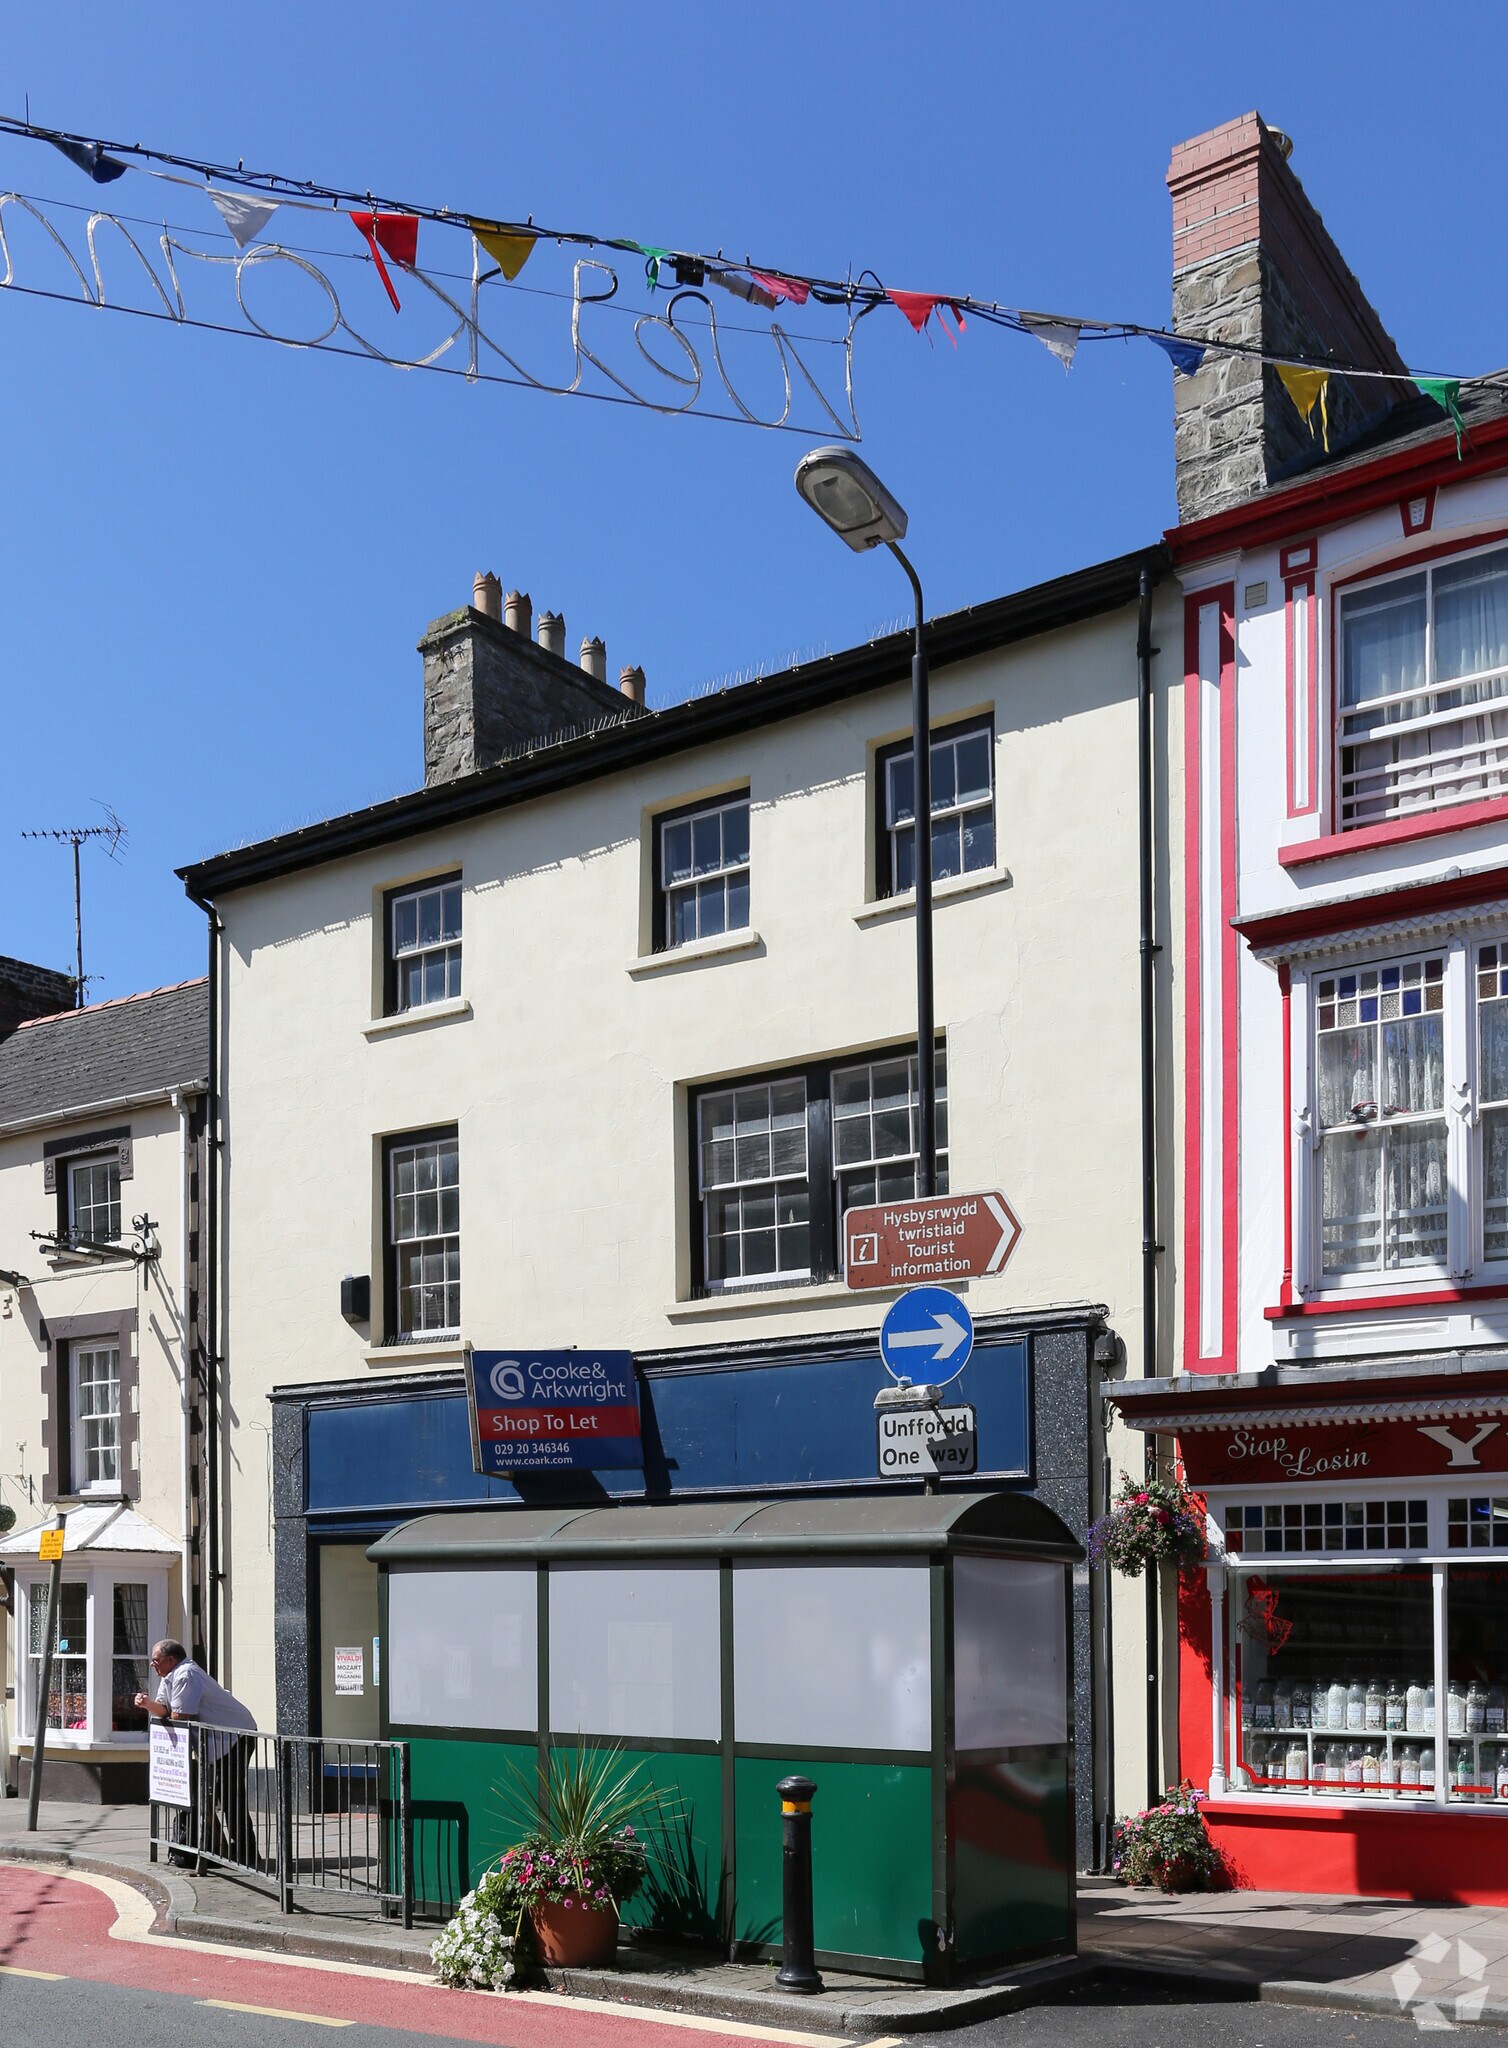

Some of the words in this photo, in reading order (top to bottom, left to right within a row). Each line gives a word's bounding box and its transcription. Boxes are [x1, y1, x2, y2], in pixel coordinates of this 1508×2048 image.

[883, 1201, 978, 1227] Hysbysrwydd
[898, 1221, 965, 1241] twristiaid
[907, 1240, 955, 1258] Tourist
[890, 1258, 971, 1277] information
[528, 1362, 607, 1380] Cooke&
[531, 1381, 627, 1401] Arkwright
[492, 1415, 540, 1434] Shop
[543, 1414, 564, 1430] To
[570, 1414, 598, 1430] Let
[884, 1414, 968, 1438] Unffordd
[494, 1443, 514, 1455] 029
[516, 1443, 529, 1454] 20
[532, 1442, 570, 1454] 346346
[1227, 1431, 1288, 1461] Siop
[1416, 1422, 1508, 1467] Y
[496, 1455, 573, 1466] www.coark.com
[882, 1448, 920, 1466] One
[930, 1447, 969, 1465] way
[1279, 1446, 1370, 1477] Losin
